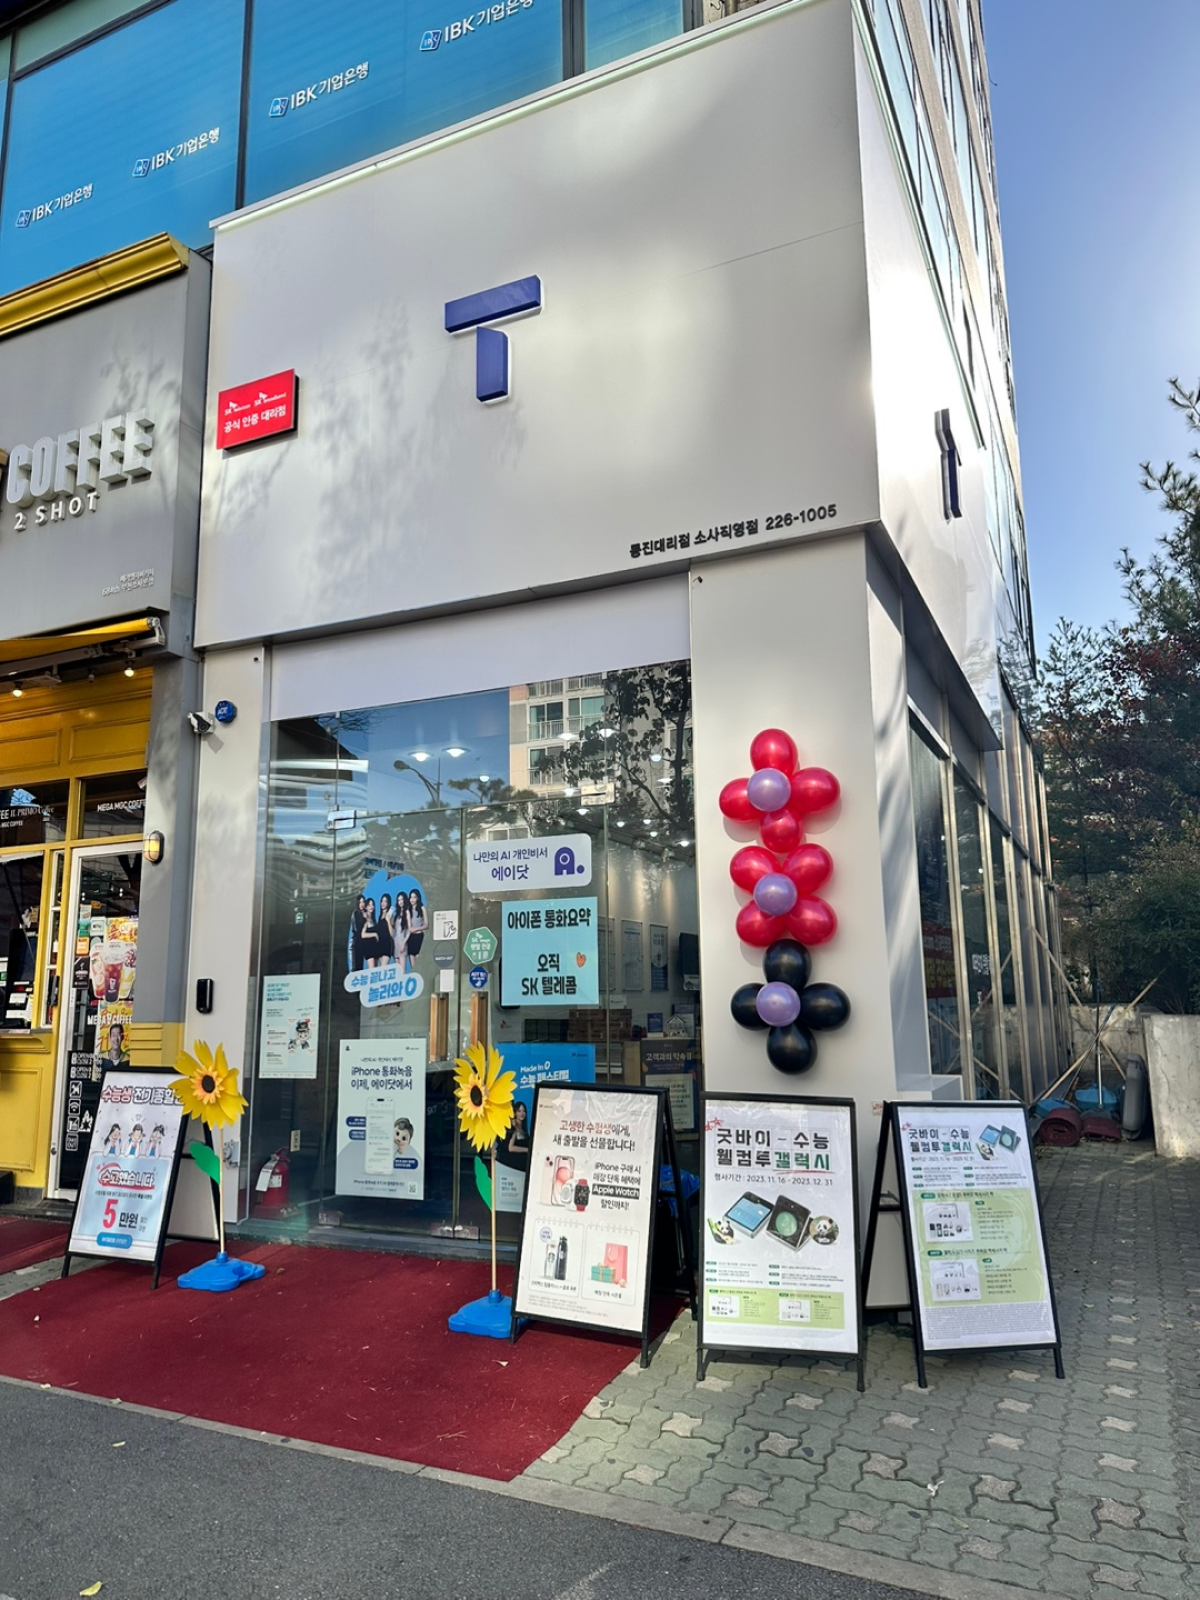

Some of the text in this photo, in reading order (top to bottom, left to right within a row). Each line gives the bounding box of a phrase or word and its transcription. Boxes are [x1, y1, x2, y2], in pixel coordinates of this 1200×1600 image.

[444, 16, 475, 42] IBK
[291, 61, 369, 109] IBK 기업은행
[152, 127, 220, 170] IBK 기업은행
[32, 183, 93, 221] IBK 기업은행
[444, 274, 542, 403] T
[224, 404, 286, 433] 공식 인증 대리점
[7, 407, 155, 508] COFFEE
[14, 491, 100, 532] 2 SHOT
[694, 518, 759, 545] 소사직영점
[765, 503, 837, 531] 226-1005
[473, 847, 548, 863] 나만의 AI 개인비서
[491, 864, 529, 881] 에이닷
[508, 908, 591, 929] 아이폰 통화요약
[537, 953, 560, 972] 오직
[351, 968, 396, 987] 수능 끝나고
[521, 976, 577, 996] SK 텔레콤
[369, 981, 403, 1002] 놀러와
[351, 1066, 380, 1076] iPhone
[520, 1064, 537, 1073] Made
[371, 1079, 413, 1090] 에이닷에서
[520, 1074, 536, 1085] 수능
[101, 1085, 133, 1103] 수능생
[560, 1120, 585, 1133] 고생한
[909, 1129, 939, 1139] 굿바이
[950, 1129, 970, 1139] 수능
[553, 1134, 562, 1145] 새
[563, 1134, 588, 1148] 출발을
[717, 1128, 771, 1147] 굿바이
[793, 1132, 829, 1150] 수능
[101, 1169, 155, 1188] 수고했습니다
[714, 1173, 741, 1182] 행사기간
[593, 1185, 639, 1197] Apple Watch
[103, 1198, 118, 1229] 5
[119, 1212, 138, 1229] 만원
